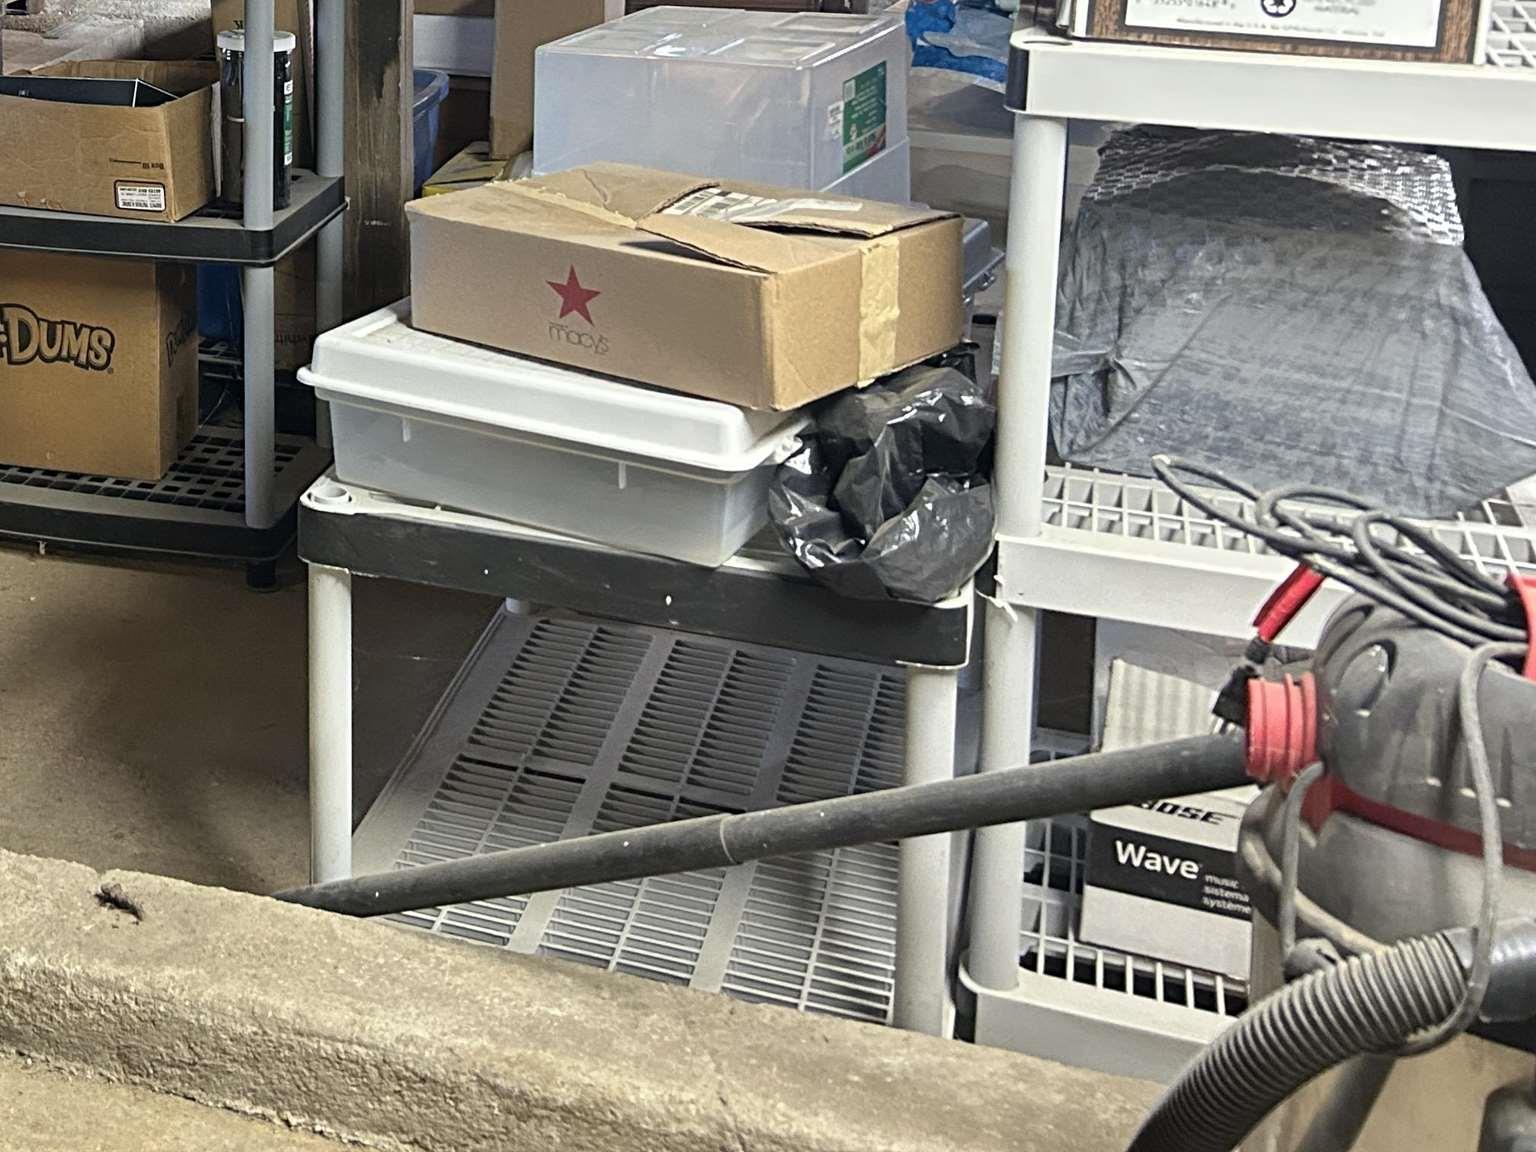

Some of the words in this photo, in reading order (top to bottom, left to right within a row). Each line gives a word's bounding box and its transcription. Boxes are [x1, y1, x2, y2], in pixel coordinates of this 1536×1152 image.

[1141, 799, 1239, 826] OSE
[1115, 839, 1200, 879] Wave
[1205, 874, 1239, 889] music
[1204, 886, 1249, 903] sistema
